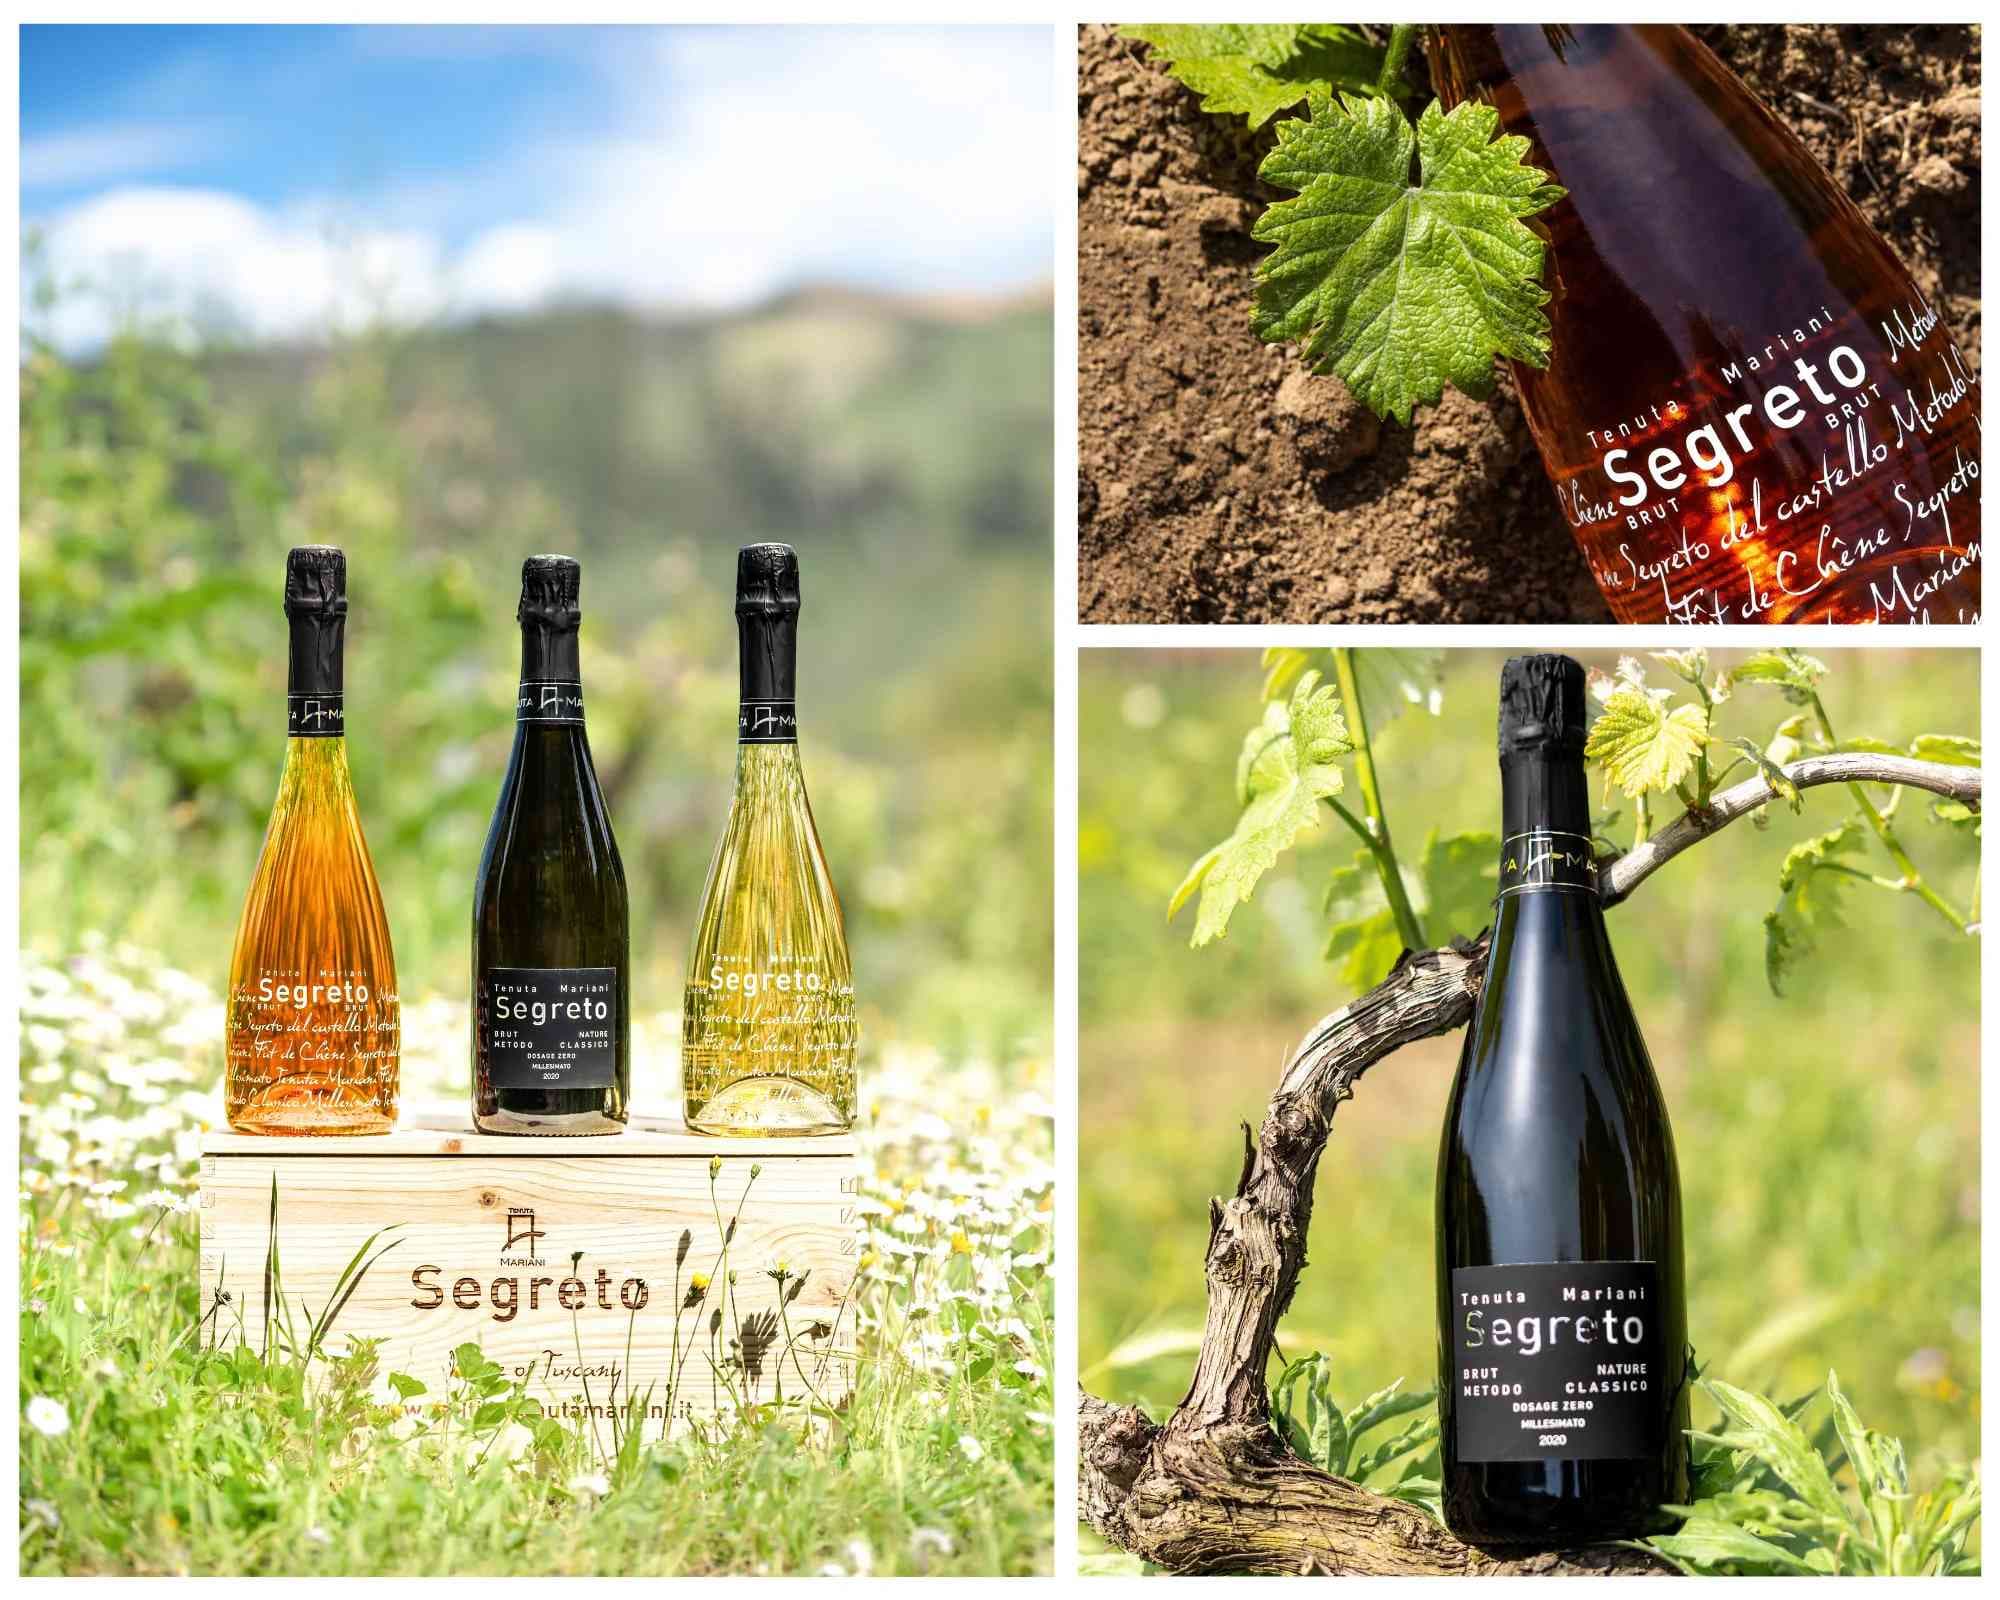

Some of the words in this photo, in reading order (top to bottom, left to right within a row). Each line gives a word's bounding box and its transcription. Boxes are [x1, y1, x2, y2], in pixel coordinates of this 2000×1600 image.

[1586, 400, 1679, 449] Tenuta
[1720, 305, 1834, 384] Mariani
[1603, 345, 1866, 507] Segreto
[1626, 497, 1679, 530] BRUT
[1824, 383, 1881, 429] BRUT
[1619, 525, 1710, 613] Segreto
[1721, 477, 1768, 550] del
[1777, 415, 1888, 509] castello
[1891, 351, 1967, 449] Metodo
[1742, 561, 1776, 619] de
[1776, 524, 1891, 597] Chêne
[1893, 445, 1980, 548] Segreto
[260, 967, 301, 977] Tenuta
[320, 967, 368, 977] Mariani
[711, 965, 820, 998] Segreto
[259, 977, 369, 1009] Segreto
[494, 983, 538, 993] Tenuta
[560, 983, 609, 993] Mariani
[257, 1002, 282, 1011] BRUT
[344, 1003, 369, 1012] BRUT
[496, 995, 608, 1026] Segreto
[286, 1011, 313, 1032] del
[311, 1012, 361, 1034] castello
[494, 1030, 519, 1038] BRUT
[579, 1030, 609, 1039] NATURE
[494, 1041, 533, 1049] METODO
[559, 1040, 609, 1049] CLASSICO
[281, 1040, 296, 1060] de
[531, 1063, 572, 1071] MILLESIMATO
[543, 1072, 561, 1080] 2020
[500, 1257, 546, 1267] MARIANI
[411, 1264, 649, 1323] Segreto
[1461, 1290, 1526, 1307] Tenuta
[1562, 1286, 1645, 1302] Mariani
[1465, 1309, 1645, 1356] Segreto
[542, 1349, 623, 1384] Tuscany
[1463, 1367, 1499, 1380] BRUT
[1597, 1363, 1647, 1376] NATURE
[1463, 1384, 1522, 1397] METODO
[1565, 1380, 1648, 1395] CLASSICO
[1512, 1401, 1559, 1413] DOSAGE
[1562, 1400, 1594, 1412] ZERO
[1520, 1417, 1587, 1430] MILLESIMATO
[1538, 1434, 1568, 1447] 2020
